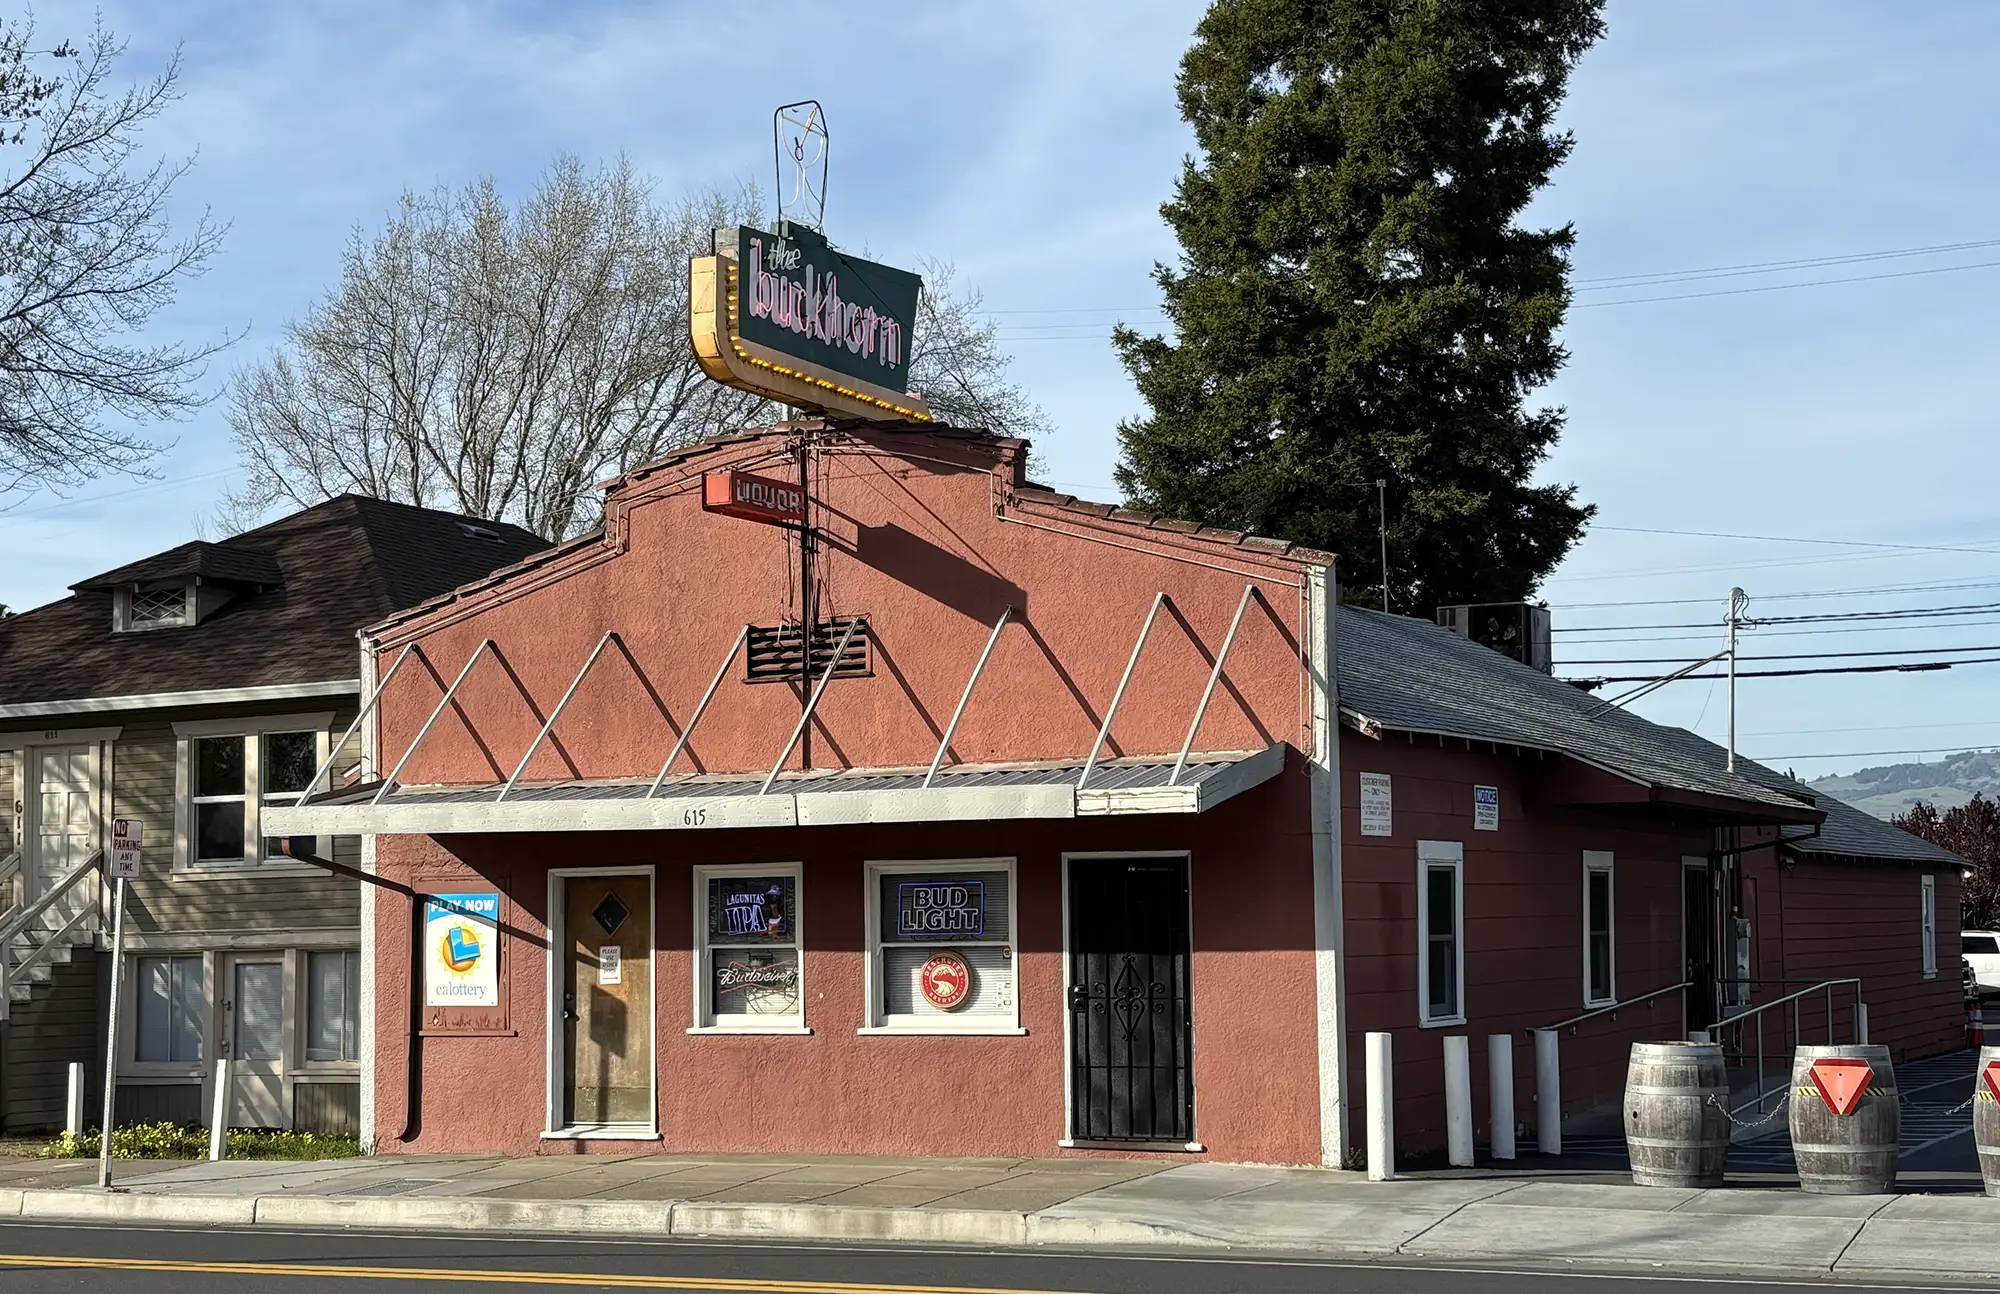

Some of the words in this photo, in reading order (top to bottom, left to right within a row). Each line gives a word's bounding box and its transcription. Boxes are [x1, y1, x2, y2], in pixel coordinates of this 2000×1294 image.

[768, 236, 801, 271] the
[749, 237, 901, 370] buckhorn
[736, 479, 801, 514] LIQUOR
[45, 730, 58, 740] 611
[1476, 789, 1496, 803] NOTICE
[684, 808, 707, 826] 615
[115, 821, 127, 835] NO
[114, 840, 141, 851] PARKING
[120, 853, 133, 861] ANY
[120, 863, 133, 872] TIME
[431, 899, 462, 912] PLAY
[465, 899, 495, 911] NOW
[726, 894, 765, 906] LAGUNITAS
[914, 887, 968, 909] BUD
[725, 904, 767, 935] IPA
[902, 908, 978, 930] LIGHT
[924, 957, 964, 977] DESCHUTES
[717, 968, 796, 985] Budweiser
[436, 981, 487, 999] calottery
